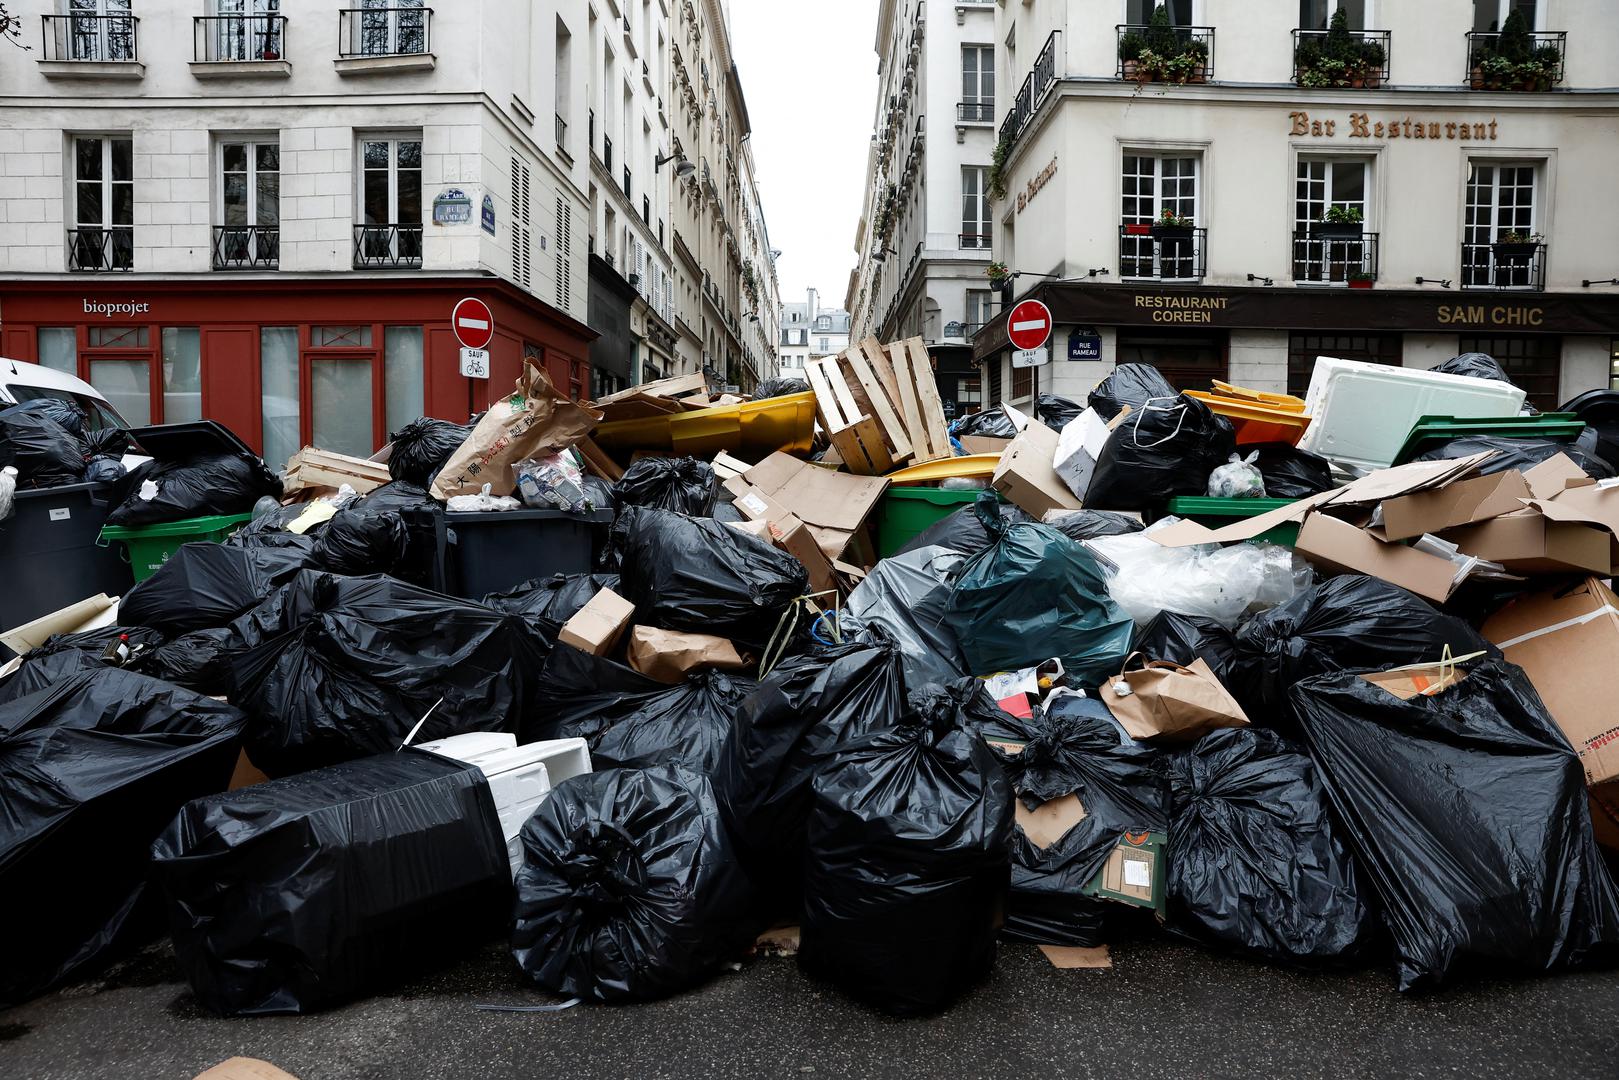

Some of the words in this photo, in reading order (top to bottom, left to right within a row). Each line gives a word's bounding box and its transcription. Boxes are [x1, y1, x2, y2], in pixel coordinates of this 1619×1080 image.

[1288, 111, 1335, 137] Bar
[1349, 112, 1498, 140] Restaurant
[83, 298, 150, 317] bioprojet
[1135, 295, 1229, 309] RESTAURANT
[1152, 310, 1211, 323] COREEN
[1437, 305, 1485, 324] SAM
[1491, 306, 1544, 326] CHIC
[468, 350, 484, 359] SAUF
[1022, 350, 1037, 358] SAUF
